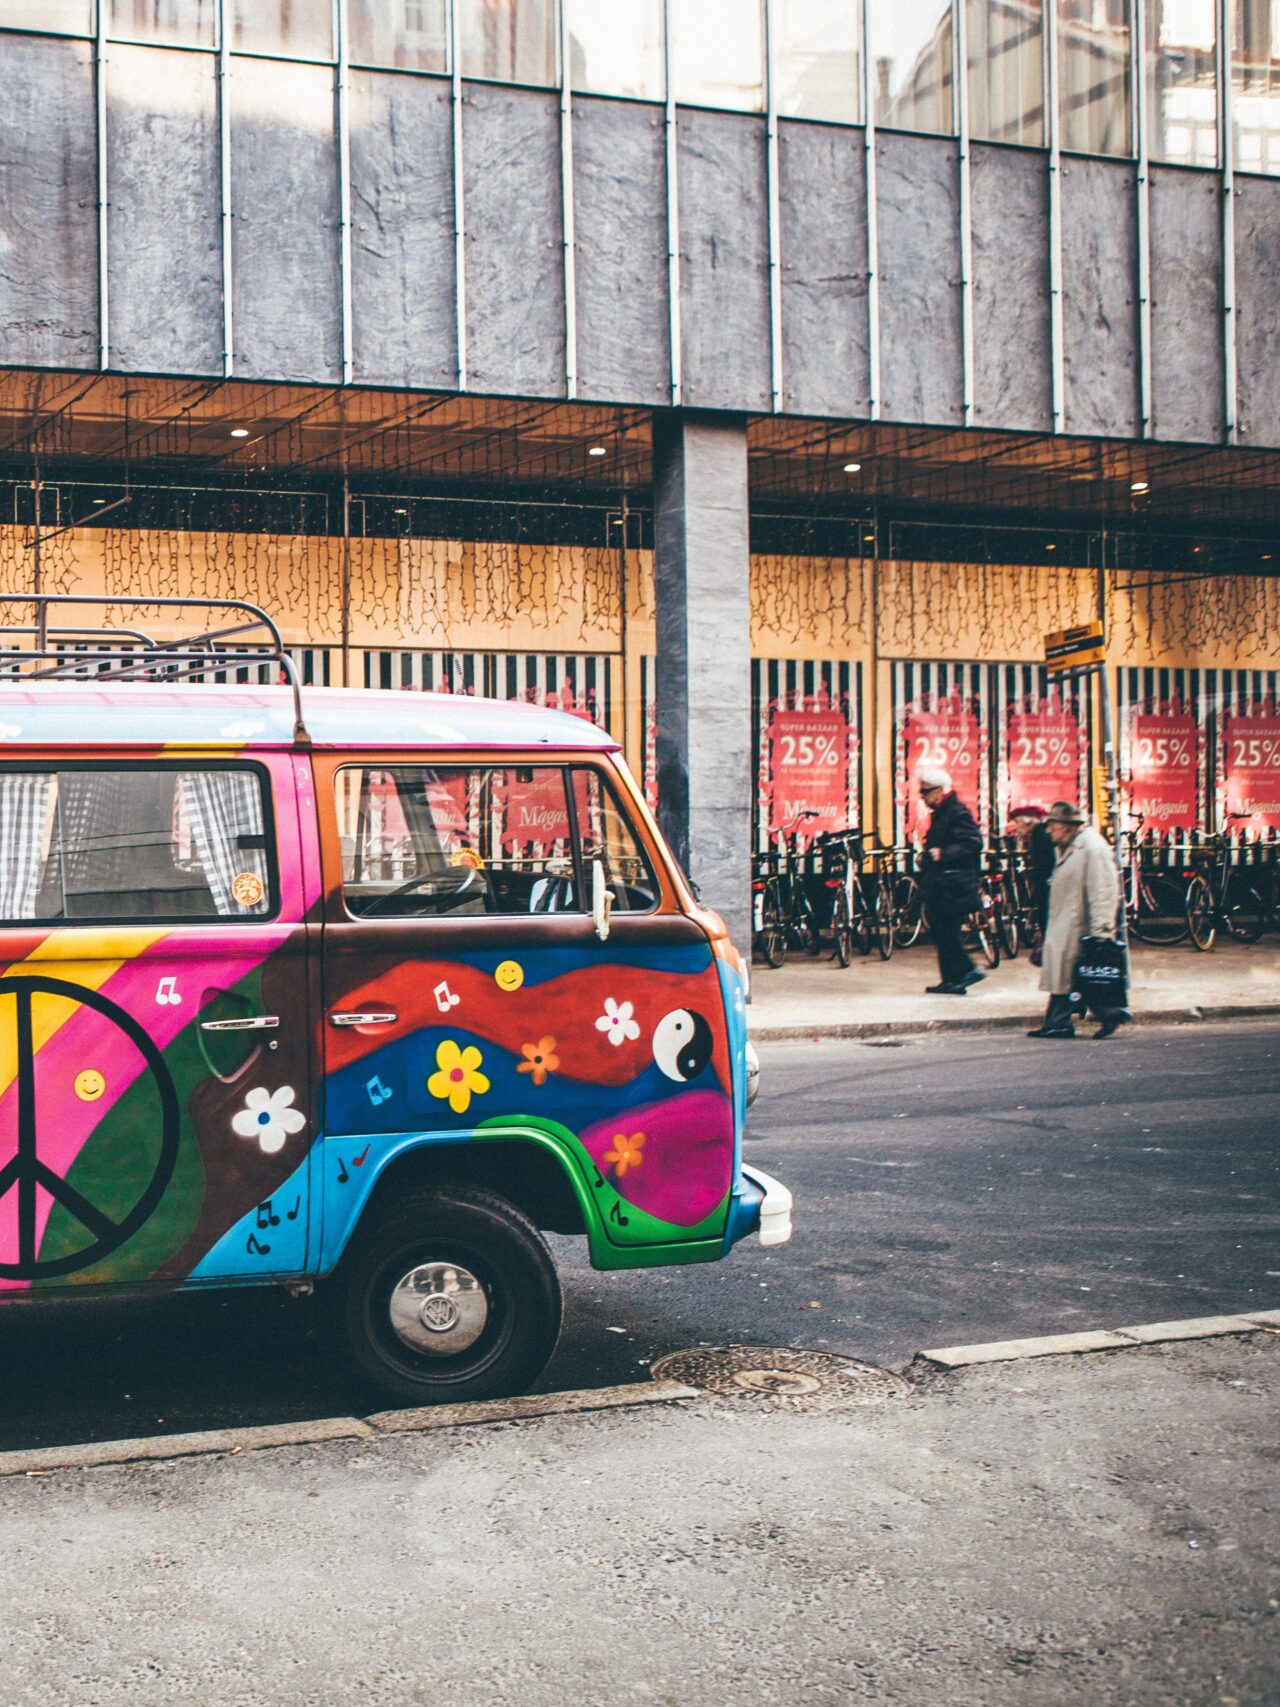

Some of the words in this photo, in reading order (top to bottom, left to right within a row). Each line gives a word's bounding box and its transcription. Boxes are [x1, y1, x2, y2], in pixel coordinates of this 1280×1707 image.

[780, 736, 839, 766] 25%
[915, 737, 971, 766] 25%
[1017, 737, 1071, 766] 25%
[1140, 738, 1190, 767] 25%
[1233, 740, 1280, 767] 25%
[423, 1297, 456, 1328] VW
